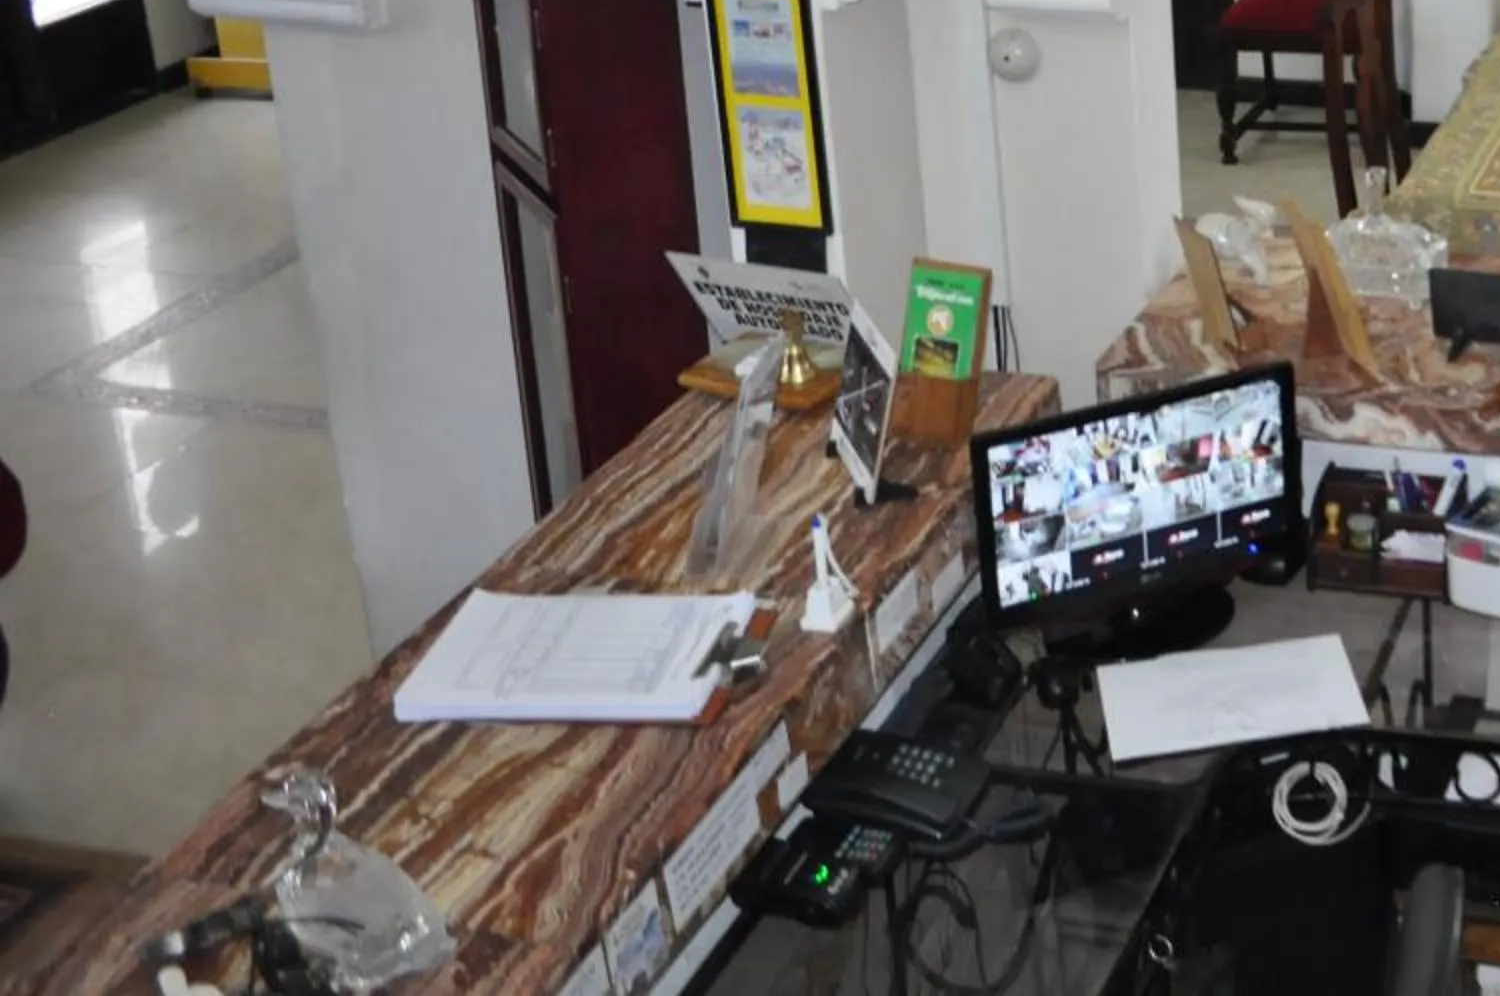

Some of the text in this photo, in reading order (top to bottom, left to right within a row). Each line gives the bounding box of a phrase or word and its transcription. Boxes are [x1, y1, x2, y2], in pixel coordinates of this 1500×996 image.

[694, 281, 849, 316] ESTABLECIMIENTO
[735, 313, 844, 341] AUTOADO
[743, 301, 843, 328] HOSDAJE
